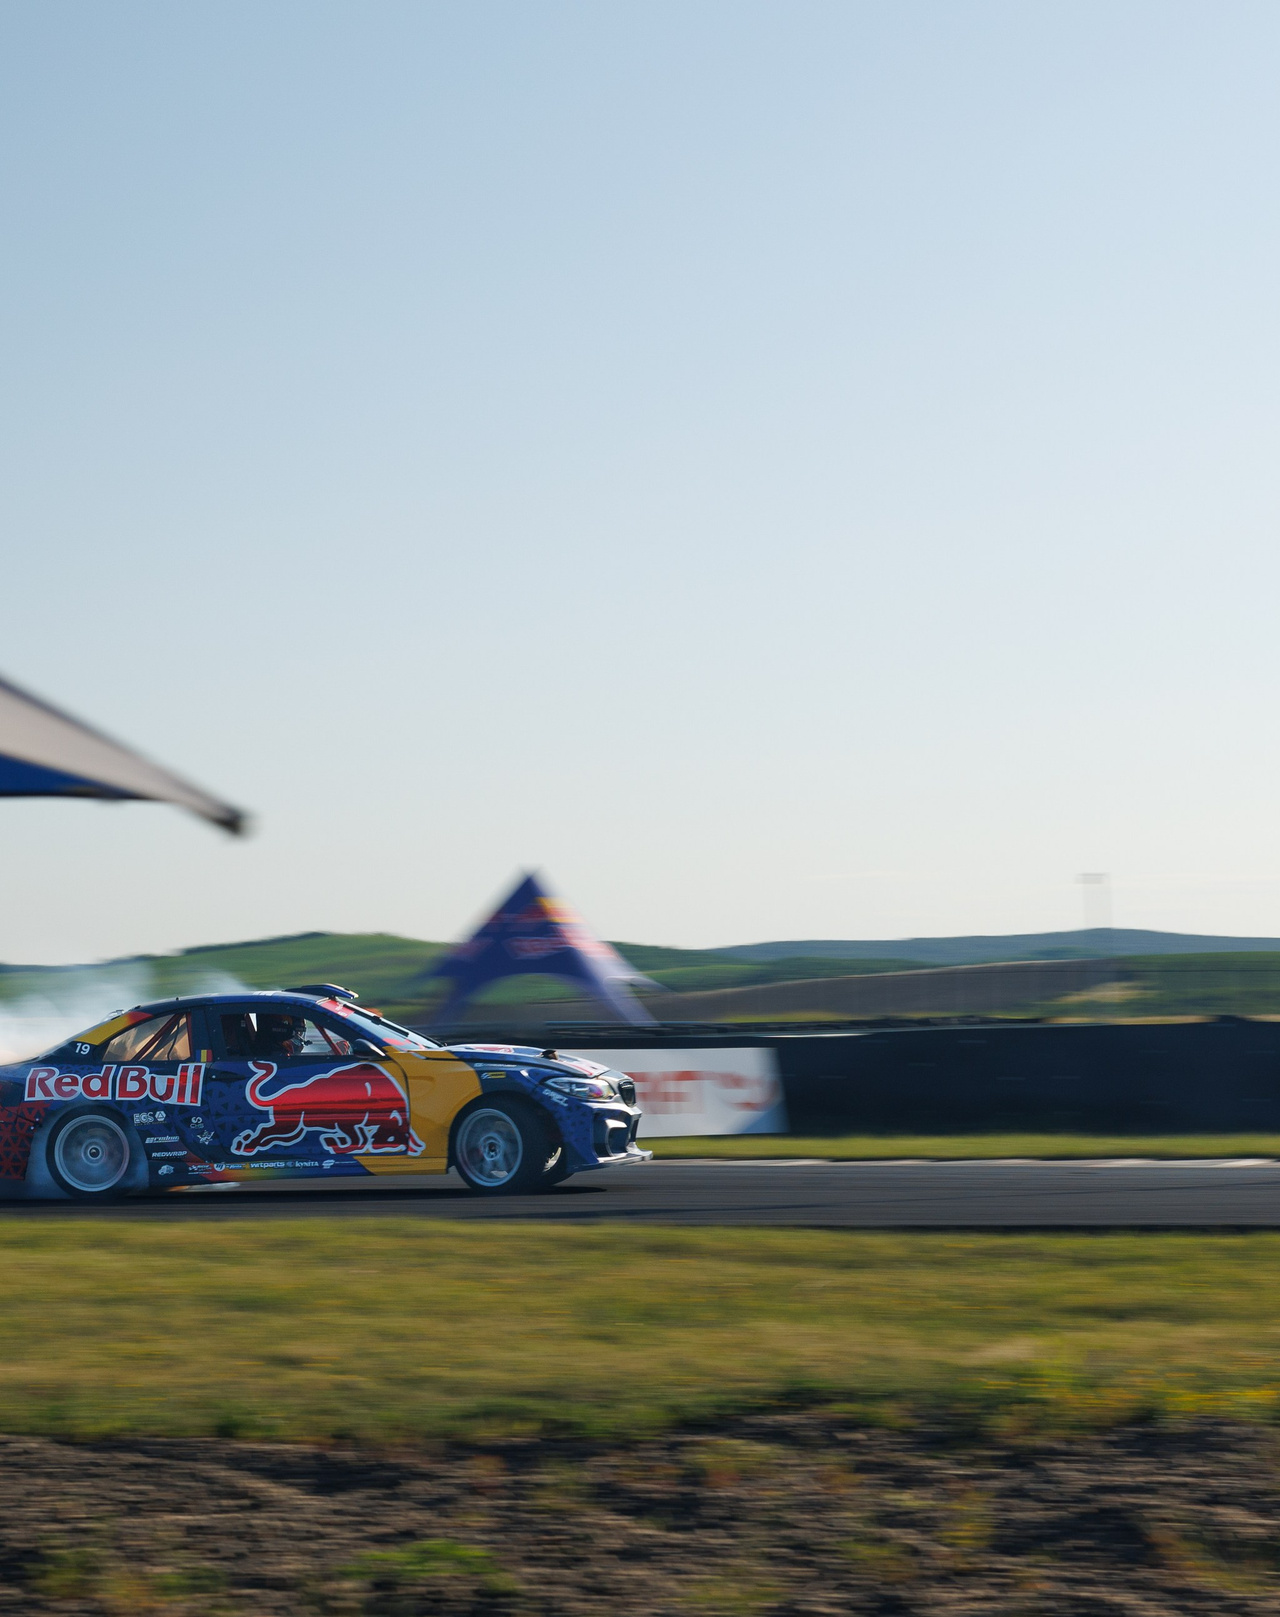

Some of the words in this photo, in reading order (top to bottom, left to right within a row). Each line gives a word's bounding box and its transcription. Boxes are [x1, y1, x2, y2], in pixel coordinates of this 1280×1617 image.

[75, 1043, 91, 1055] 19
[24, 1064, 117, 1101] Red
[116, 1063, 206, 1106] Bull
[133, 1112, 154, 1124] EGS
